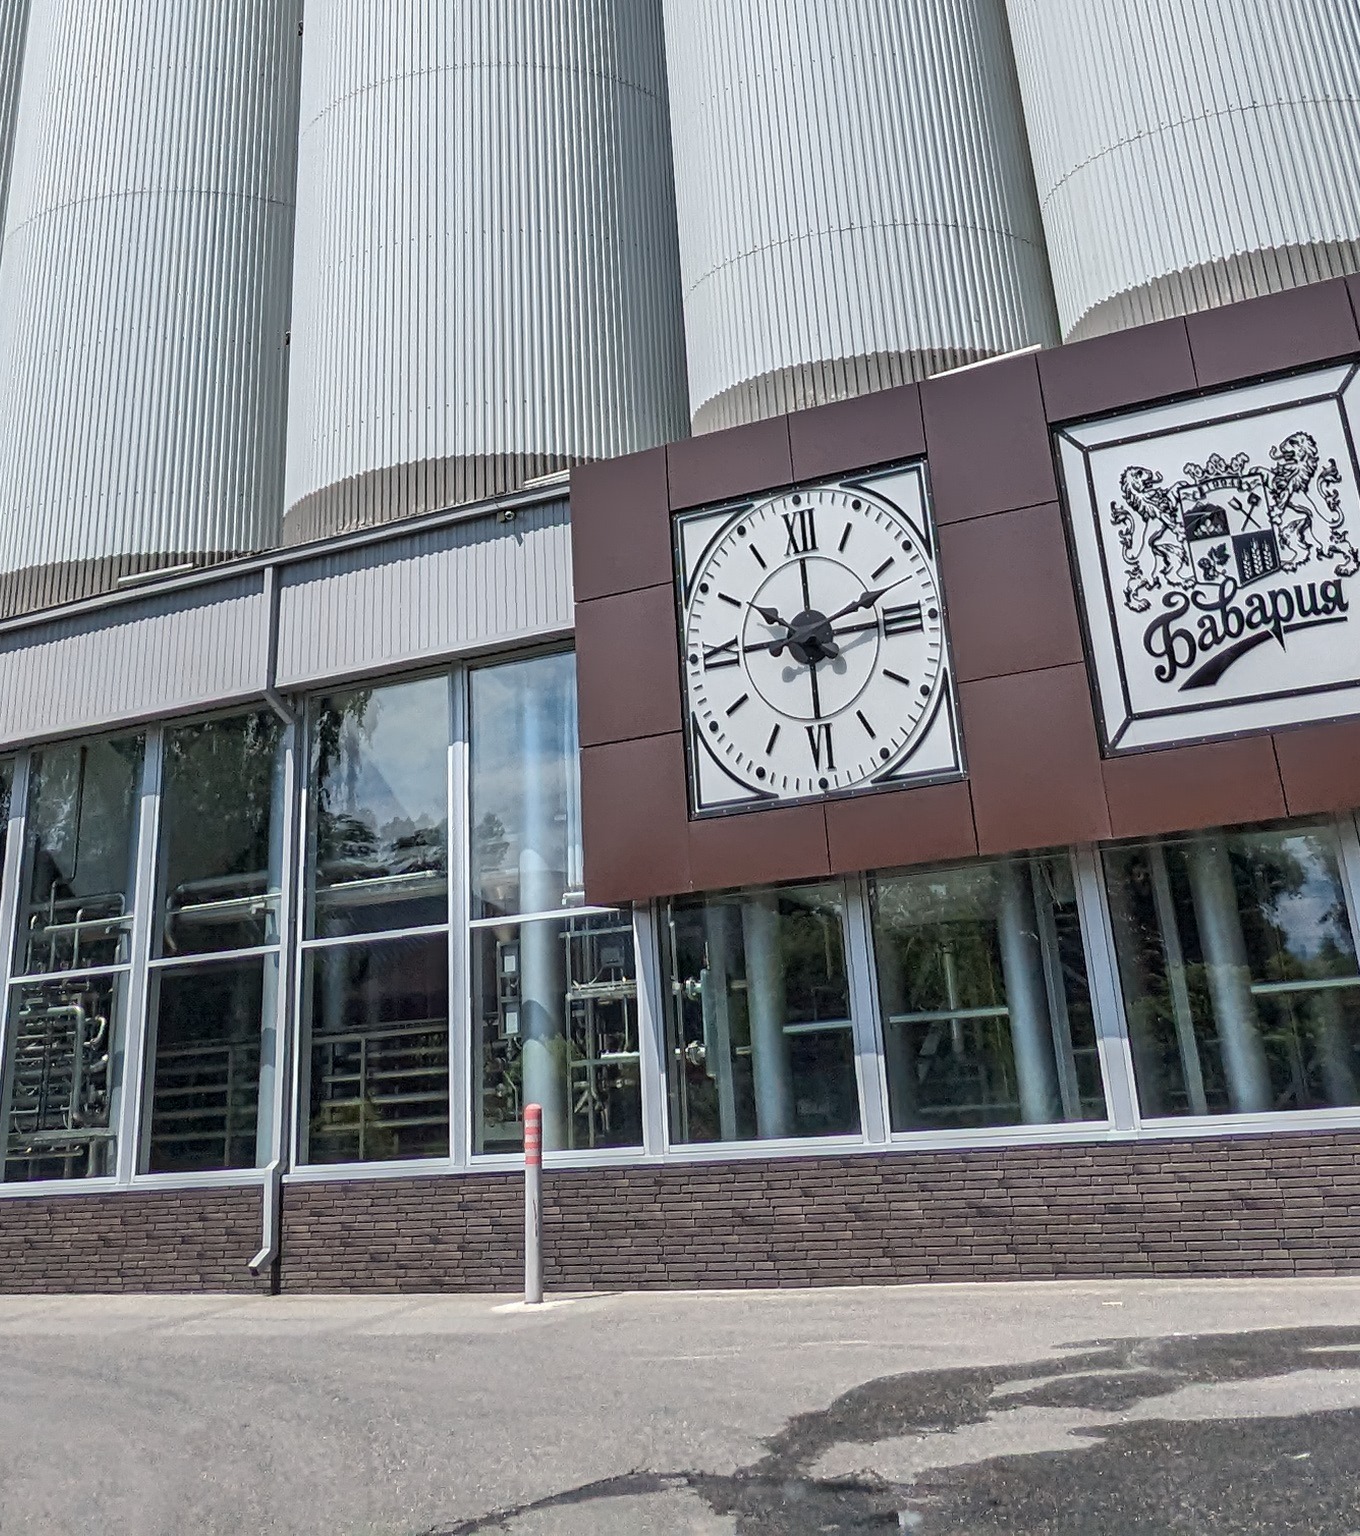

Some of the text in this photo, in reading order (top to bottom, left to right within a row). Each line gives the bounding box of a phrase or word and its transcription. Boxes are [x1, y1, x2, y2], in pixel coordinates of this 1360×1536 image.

[782, 507, 819, 557] XII
[882, 600, 925, 638] III
[1143, 574, 1350, 683] Бавария
[701, 636, 741, 672] IX
[804, 723, 837, 772] VI
